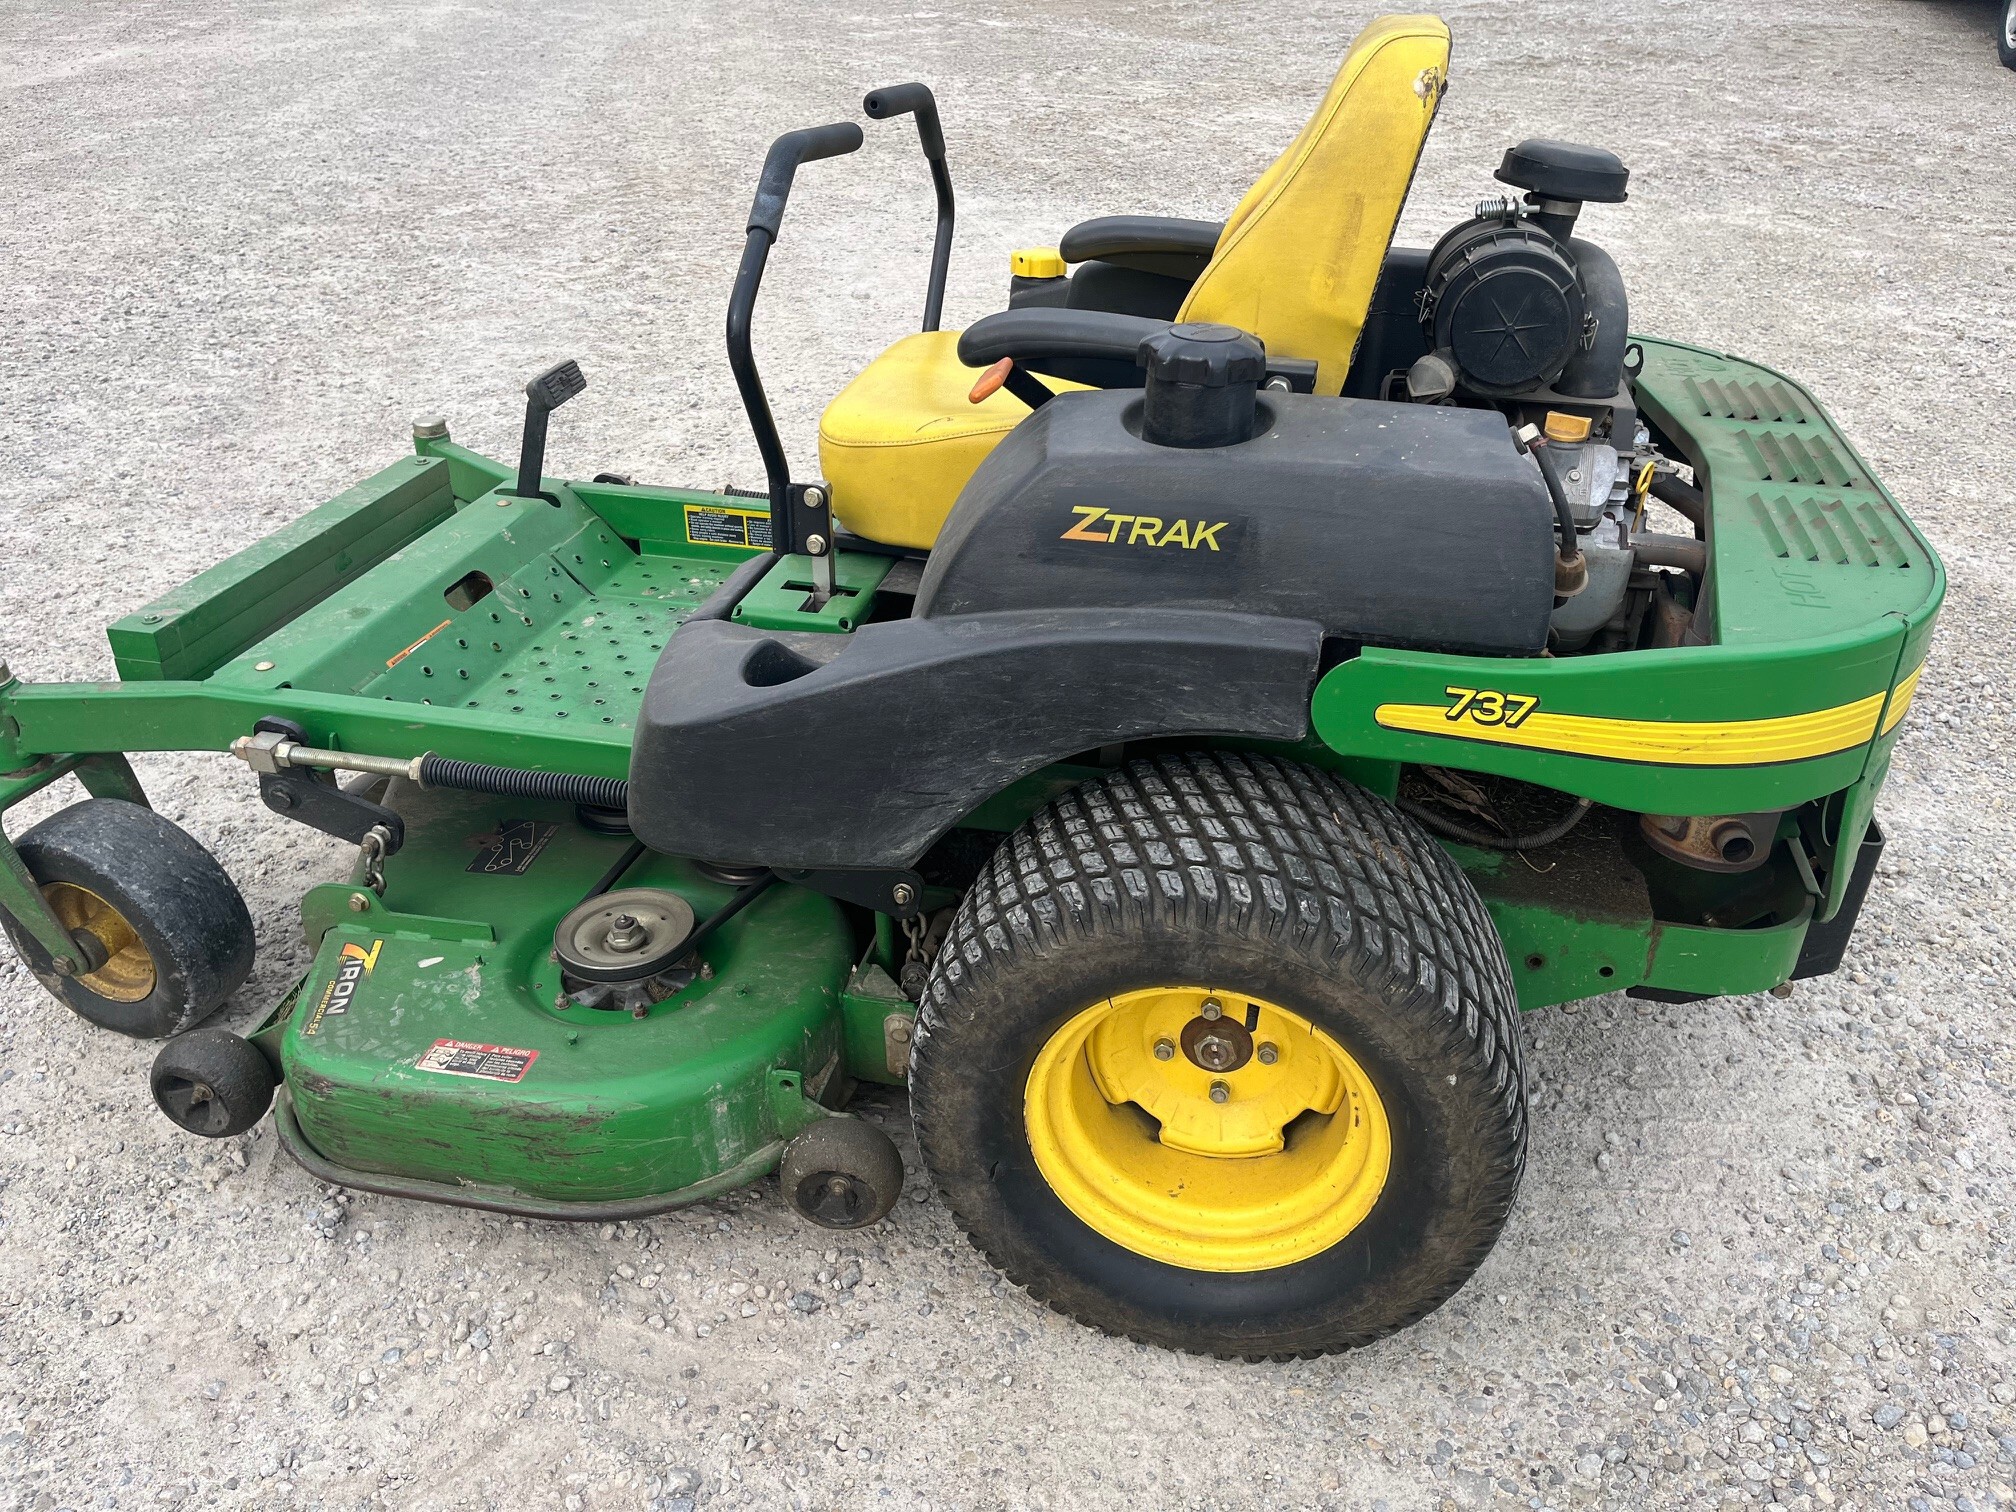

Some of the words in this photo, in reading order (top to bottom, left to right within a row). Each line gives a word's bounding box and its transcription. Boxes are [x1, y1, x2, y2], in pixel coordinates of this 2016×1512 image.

[1059, 505, 1230, 552] ZTRAK
[1445, 685, 1541, 729] 737
[314, 980, 335, 1023] COMMERCIAL
[306, 1023, 319, 1035] 54
[454, 1041, 483, 1050] DANGER
[501, 1047, 531, 1056] PELIGRO
